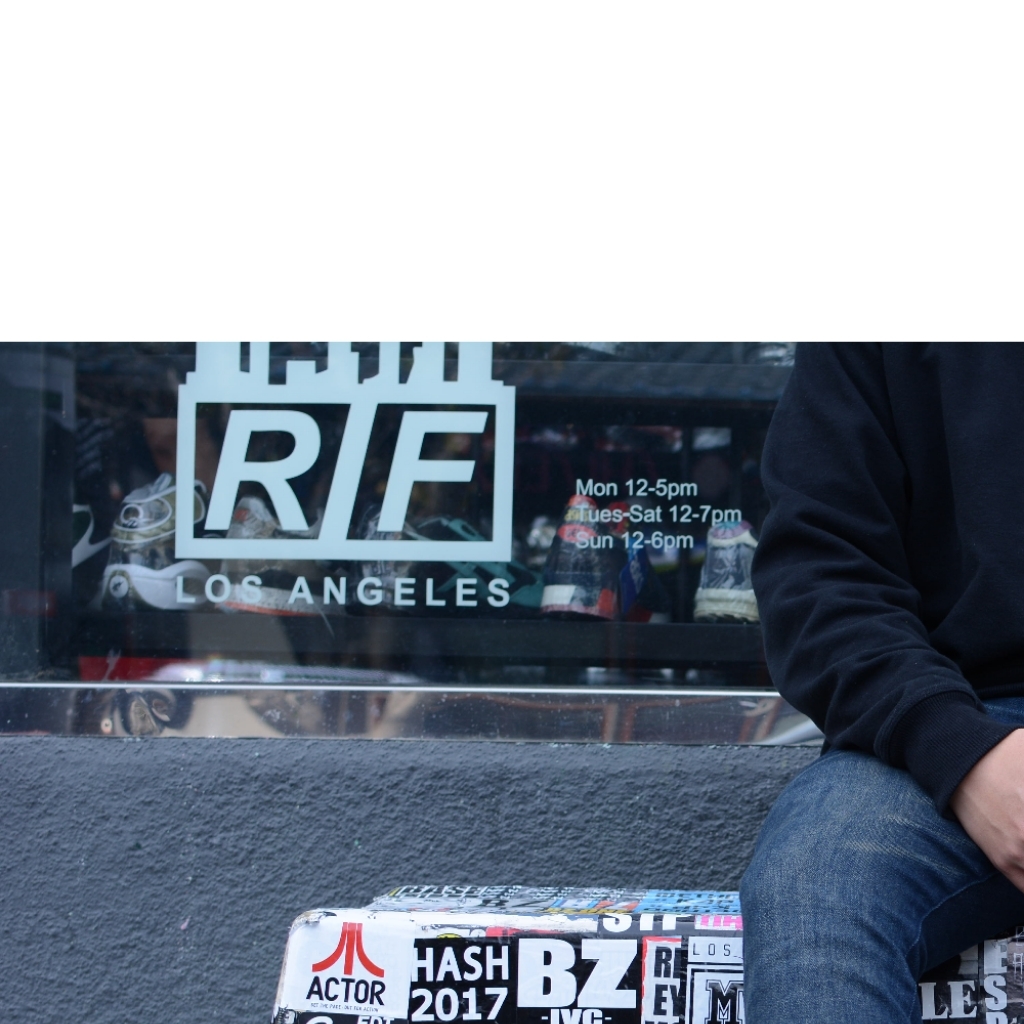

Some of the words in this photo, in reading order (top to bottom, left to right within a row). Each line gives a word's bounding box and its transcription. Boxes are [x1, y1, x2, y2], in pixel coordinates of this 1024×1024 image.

[576, 479, 618, 496] Mon
[625, 479, 698, 500] 12-5pm
[576, 505, 662, 522] Tues-Sat
[669, 505, 742, 527] 12-7pm
[576, 531, 613, 549] Sun
[621, 531, 694, 553] 12-6pm
[177, 575, 262, 604] LOS
[288, 576, 510, 607] ANGELES
[411, 945, 508, 982] HASH
[693, 943, 731, 957] LOS
[517, 938, 638, 1009] BZ
[306, 976, 386, 1006] ACTOR
[411, 987, 508, 1022] 2017
